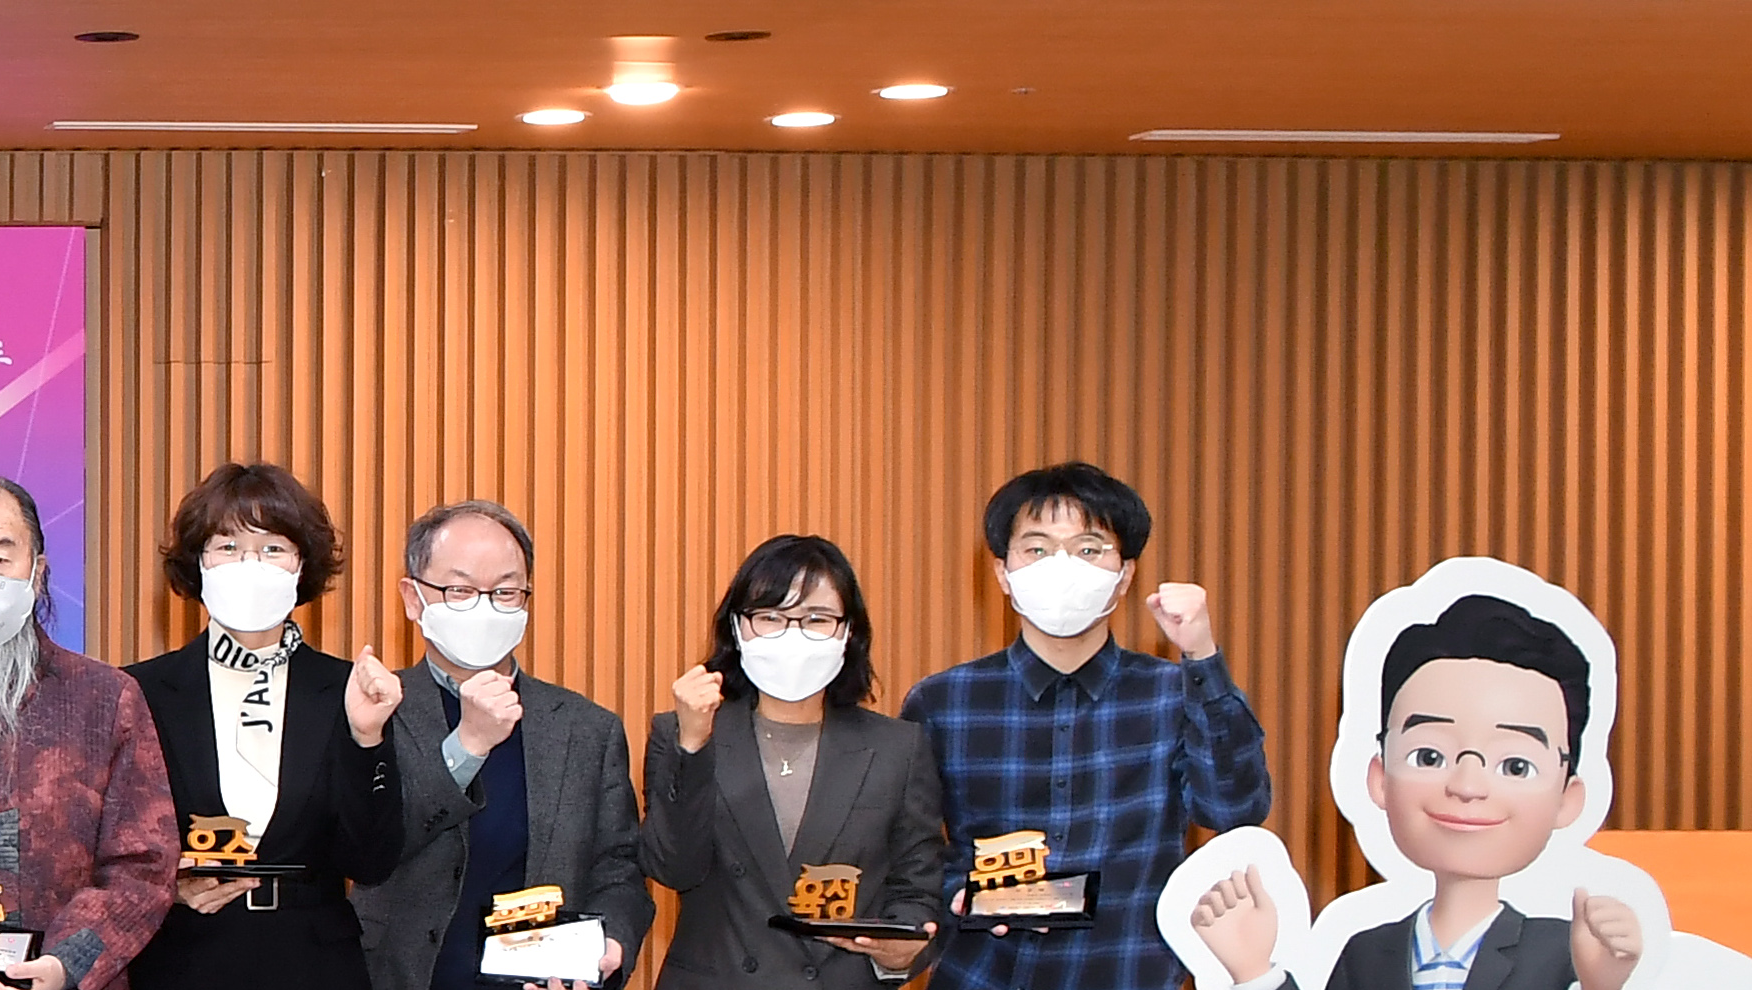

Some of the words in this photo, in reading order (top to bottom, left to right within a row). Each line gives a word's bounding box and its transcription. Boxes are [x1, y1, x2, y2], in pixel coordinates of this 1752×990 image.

[181, 829, 258, 866] 우수
[969, 846, 1050, 890] 유망
[788, 877, 859, 920] 육성
